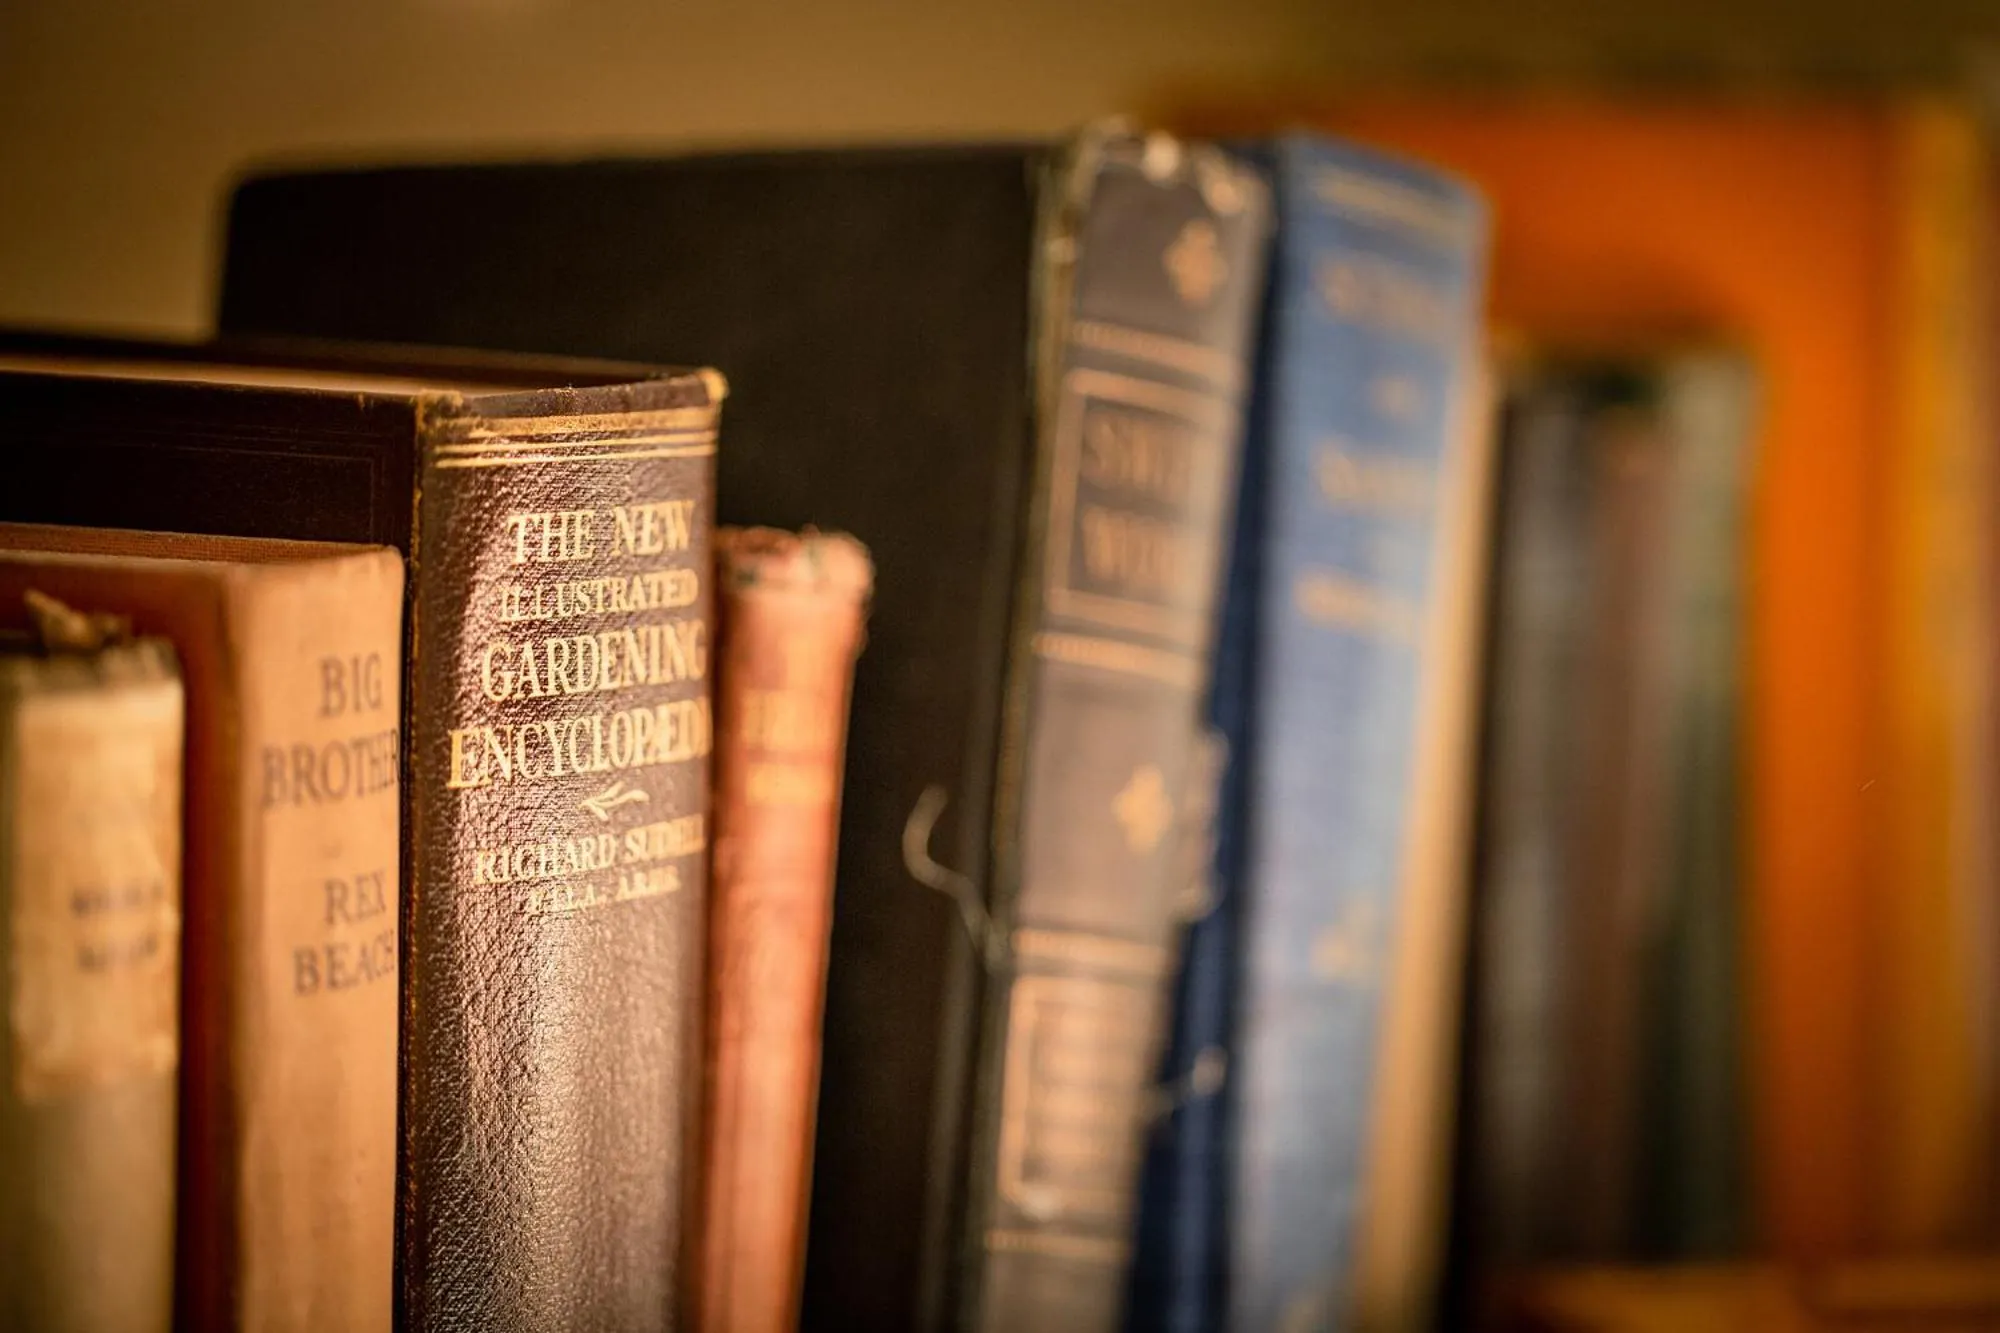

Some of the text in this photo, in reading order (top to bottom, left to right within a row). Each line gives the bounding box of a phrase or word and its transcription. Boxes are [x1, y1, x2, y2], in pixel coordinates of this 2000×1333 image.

[507, 501, 693, 565] THE NEW
[499, 568, 699, 622] ILLUSTRATED
[319, 652, 382, 718] BIG
[481, 619, 707, 701] GARDENING
[258, 728, 400, 810] BROTHER
[472, 834, 616, 886] RICHARD
[325, 870, 386, 926] REX
[293, 929, 395, 995] BEACH
